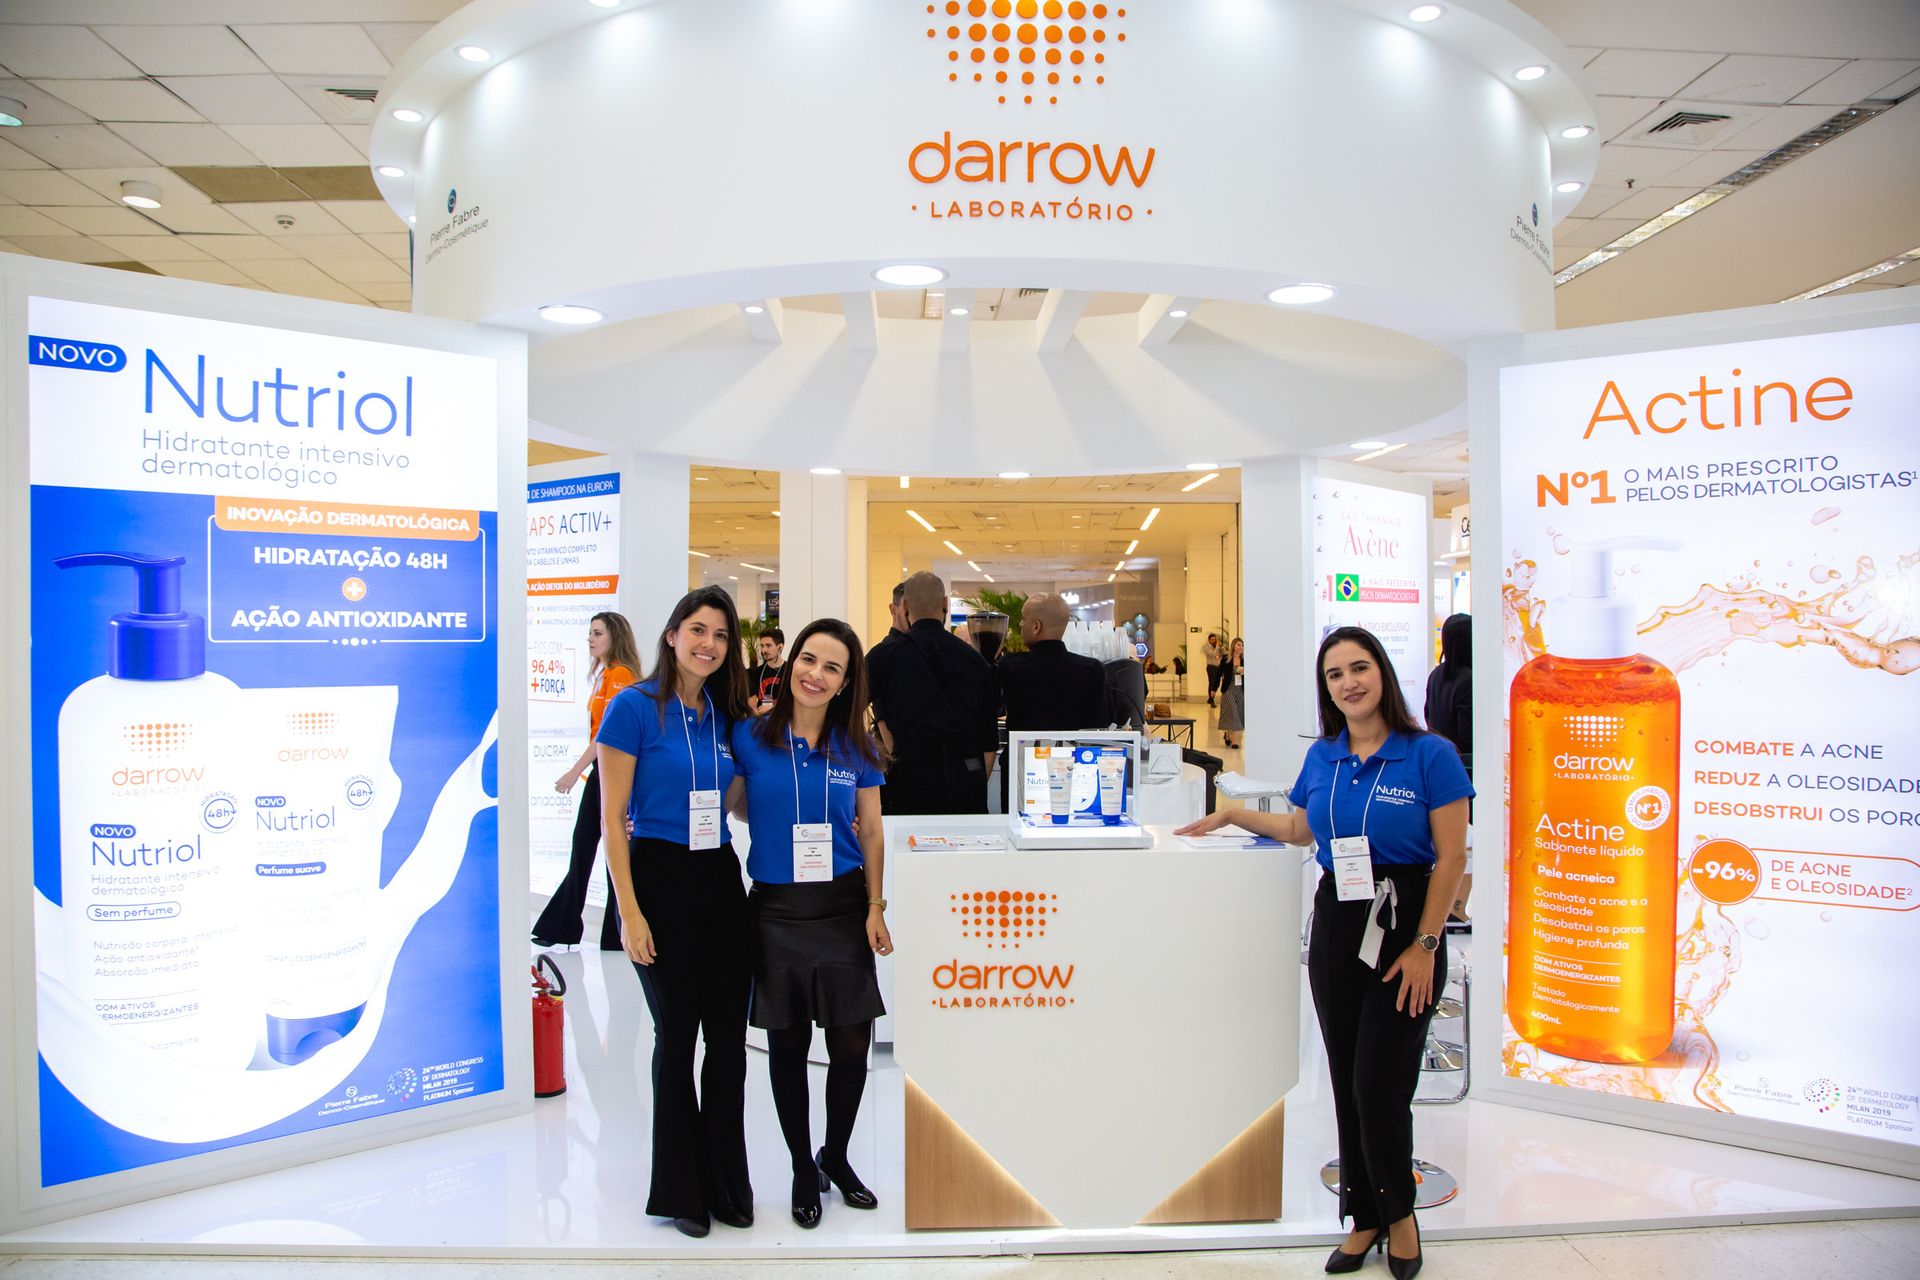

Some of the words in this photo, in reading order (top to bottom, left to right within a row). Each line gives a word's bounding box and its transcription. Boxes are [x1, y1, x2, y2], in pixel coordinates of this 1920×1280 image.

[908, 131, 1155, 188] darrow
[452, 206, 480, 228] Fabre
[930, 196, 1133, 221] LABORATÓRIO
[38, 342, 117, 367] NOVO
[145, 349, 413, 437] Nutriol
[1583, 368, 1853, 439] Actine
[143, 429, 290, 460] Hidratante
[299, 442, 410, 469] intensivo
[142, 456, 338, 488] dermatológico
[1624, 469, 1640, 483] O
[1647, 464, 1700, 482] MAIS
[1707, 455, 1839, 478] PRESCRITO
[531, 489, 541, 499] DE
[540, 485, 576, 498] SHAMPOOS
[576, 484, 587, 493] NA
[1626, 486, 1689, 503] PELOS
[227, 505, 324, 527] INOVAÇÃO
[327, 511, 471, 533] DERMATOLÓGICA
[559, 511, 612, 534] ACTIV+
[1343, 525, 1399, 559] Avène
[254, 546, 401, 572] HIDRATAÇÃO
[406, 552, 448, 570] 48H
[231, 610, 301, 633] AÇÃO
[306, 610, 467, 629] ANTIOXIDANTE
[531, 659, 566, 675] 96,4%
[278, 747, 349, 762] darrow
[534, 744, 569, 757] DUCRAY
[1694, 740, 1795, 757] COMBATE
[1800, 743, 1815, 757] A
[1822, 744, 1884, 760] ACNE
[1553, 752, 1634, 772] darrow
[112, 767, 205, 786] darrow
[1557, 772, 1631, 782] LABORATÓRIO
[1694, 770, 1761, 787] REDUZ
[1767, 774, 1781, 788] A
[257, 798, 284, 806] NOVO
[208, 809, 230, 818] 48h
[256, 806, 335, 831] Nutriol
[1694, 801, 1823, 822] DESOBSTRUI
[1829, 808, 1860, 824] OS
[94, 826, 134, 838] NOVO
[1535, 813, 1625, 842] Actine
[92, 834, 201, 867] Nutriol
[1535, 837, 1597, 856] Sabonete
[1600, 845, 1645, 859] líquido
[258, 866, 294, 875] Perfume
[1537, 865, 1563, 879] Pele
[1565, 871, 1616, 884] acneica
[1693, 860, 1756, 883] -96%
[1772, 860, 1795, 873] DE
[1800, 862, 1852, 877] ACNE
[91, 874, 161, 885] Hidratante
[1771, 878, 1781, 889] E
[1533, 886, 1586, 904] Combate
[1588, 897, 1597, 905] a
[1598, 898, 1627, 906] acne
[1630, 898, 1637, 906] e
[1640, 898, 1648, 906] a
[94, 908, 121, 917] Sem
[123, 905, 174, 920] perfume
[1533, 899, 1594, 916] oleosidade
[1533, 913, 1593, 933] Desobstrui
[1595, 924, 1610, 933] os
[1612, 925, 1646, 936] poros
[1533, 928, 1574, 945] Higiene
[1576, 938, 1630, 952] profunda
[1533, 955, 1552, 965] COM
[1553, 959, 1583, 971] ATIVOS
[932, 959, 1075, 990] darrow
[1533, 964, 1621, 983] DERMOENERGIZANTES
[1532, 982, 1566, 997] Testado
[96, 1004, 118, 1012] COM
[121, 1001, 156, 1011] ATIVOS
[939, 993, 1066, 1008] LABORATÓRIO
[1532, 991, 1620, 1013] Dermatologicamente
[1734, 1084, 1762, 1094] Pierre
[1765, 1089, 1793, 1099] Fabre
[1863, 1089, 1889, 1099] WORLD
[324, 1099, 351, 1109] Pierre
[353, 1094, 379, 1103] Fabre
[1847, 1104, 1870, 1113] MILAN
[1872, 1107, 1891, 1117] 2019
[1858, 1096, 1910, 1110] DERMATOLOGY
[1847, 1115, 1883, 1127] PLATINUM
[1884, 1121, 1914, 1132] Sponsor
